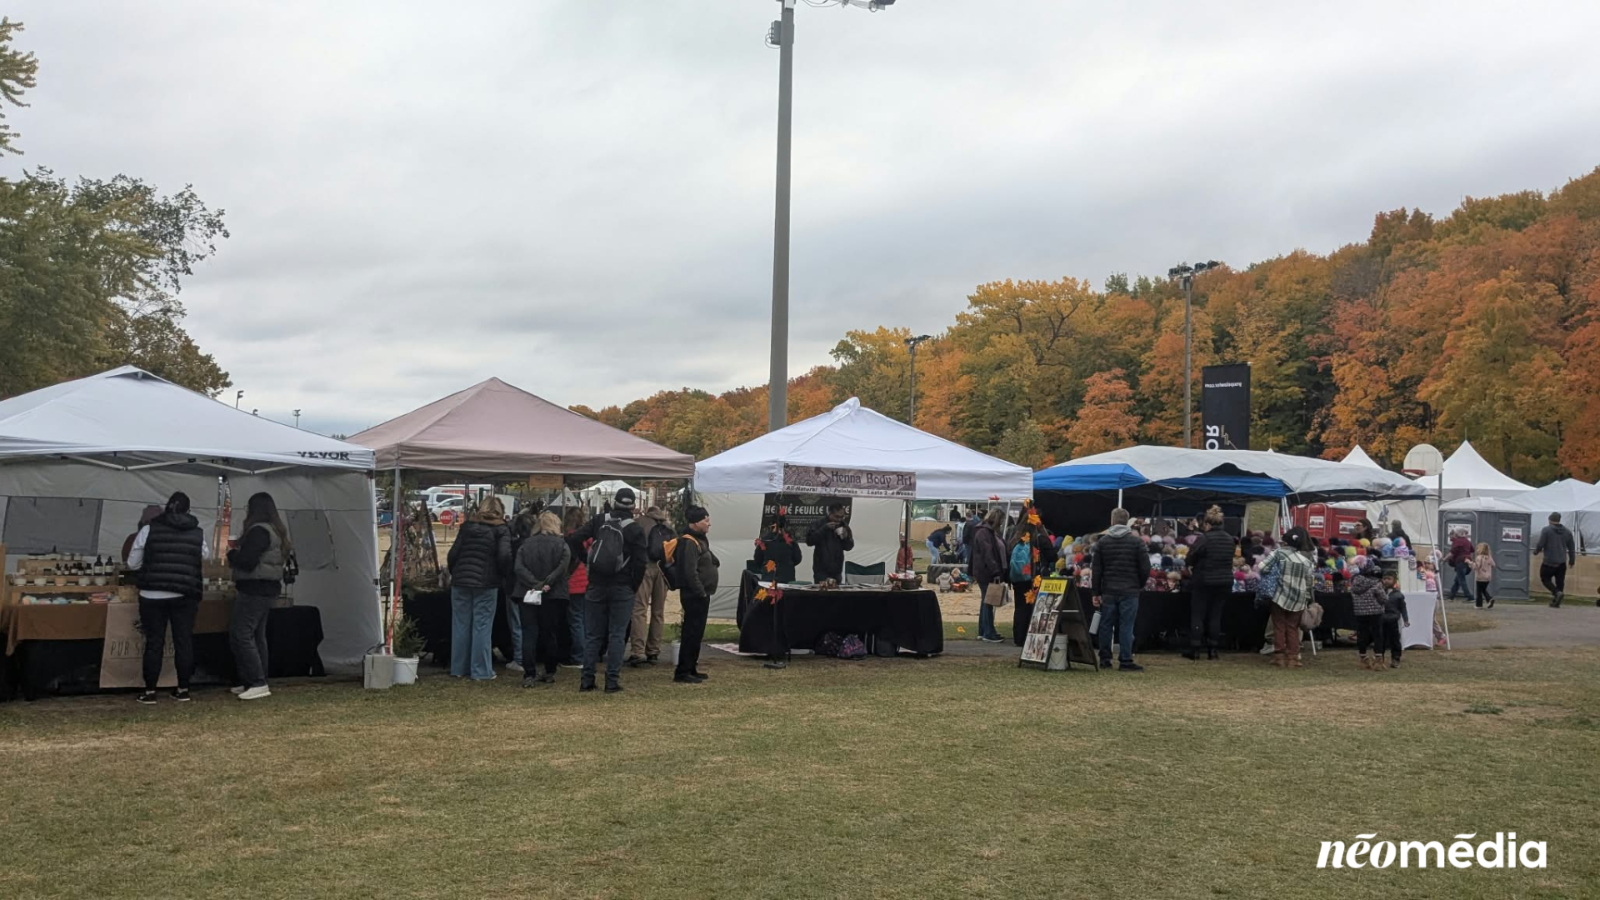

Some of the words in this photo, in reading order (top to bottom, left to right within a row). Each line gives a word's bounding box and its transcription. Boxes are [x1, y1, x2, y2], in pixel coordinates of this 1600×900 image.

[831, 471, 861, 484] Henna
[866, 472, 892, 488] Body
[896, 474, 912, 486] Art
[794, 505, 823, 514] FEUILLE
